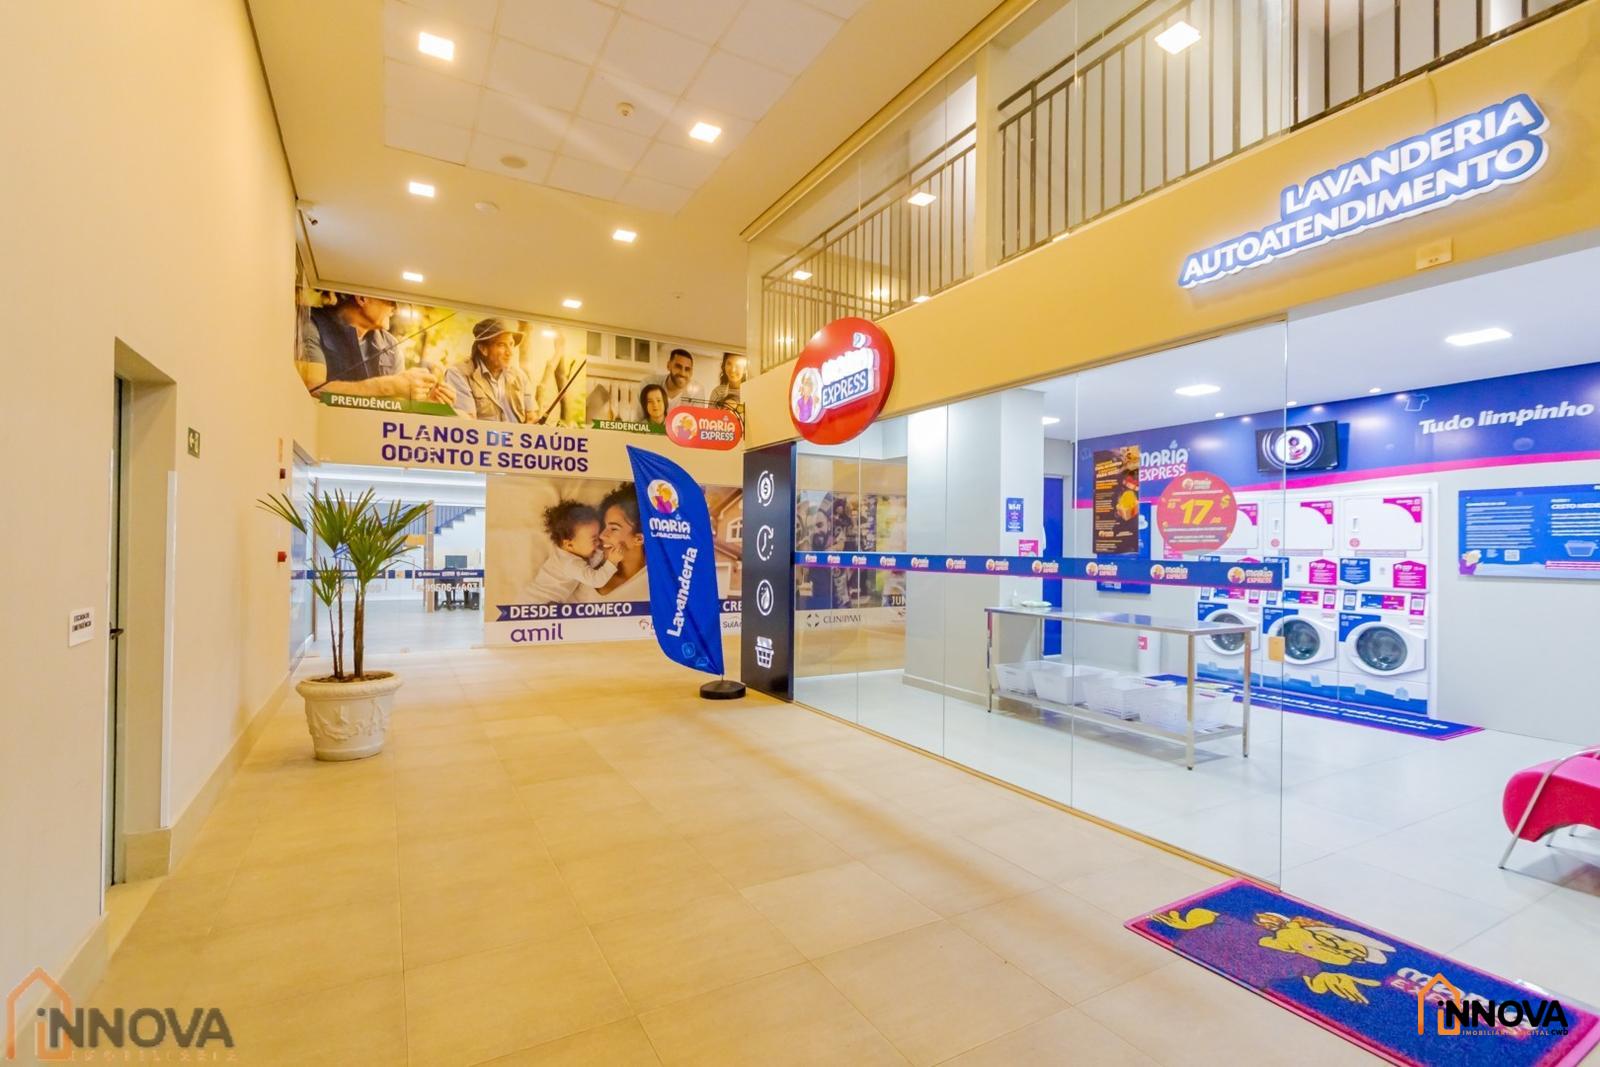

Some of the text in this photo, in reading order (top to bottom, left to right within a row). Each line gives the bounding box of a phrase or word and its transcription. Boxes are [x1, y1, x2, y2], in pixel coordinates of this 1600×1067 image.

[1285, 100, 1535, 215] LAVANDERIA
[1182, 139, 1535, 282] AUTOATENDIMENTO
[822, 371, 868, 405] EXPRESS
[330, 394, 402, 411] PREVIDÊNCIA
[600, 420, 651, 432] RESIDENCIAL
[698, 418, 736, 432] MARIA
[1419, 401, 1595, 435] Tudo limpinho
[382, 421, 589, 453] PLANOS DE SAÚDE
[700, 430, 734, 441] EXPRESS
[381, 444, 589, 473] ODONTO E SEGUROS
[1139, 464, 1187, 482] EXPRESS
[1180, 498, 1214, 526] 17
[649, 517, 691, 534] MARIA
[666, 546, 698, 638] Lavanderia
[510, 602, 632, 619] DESDE O COMEÇO
[510, 623, 564, 643] amil
